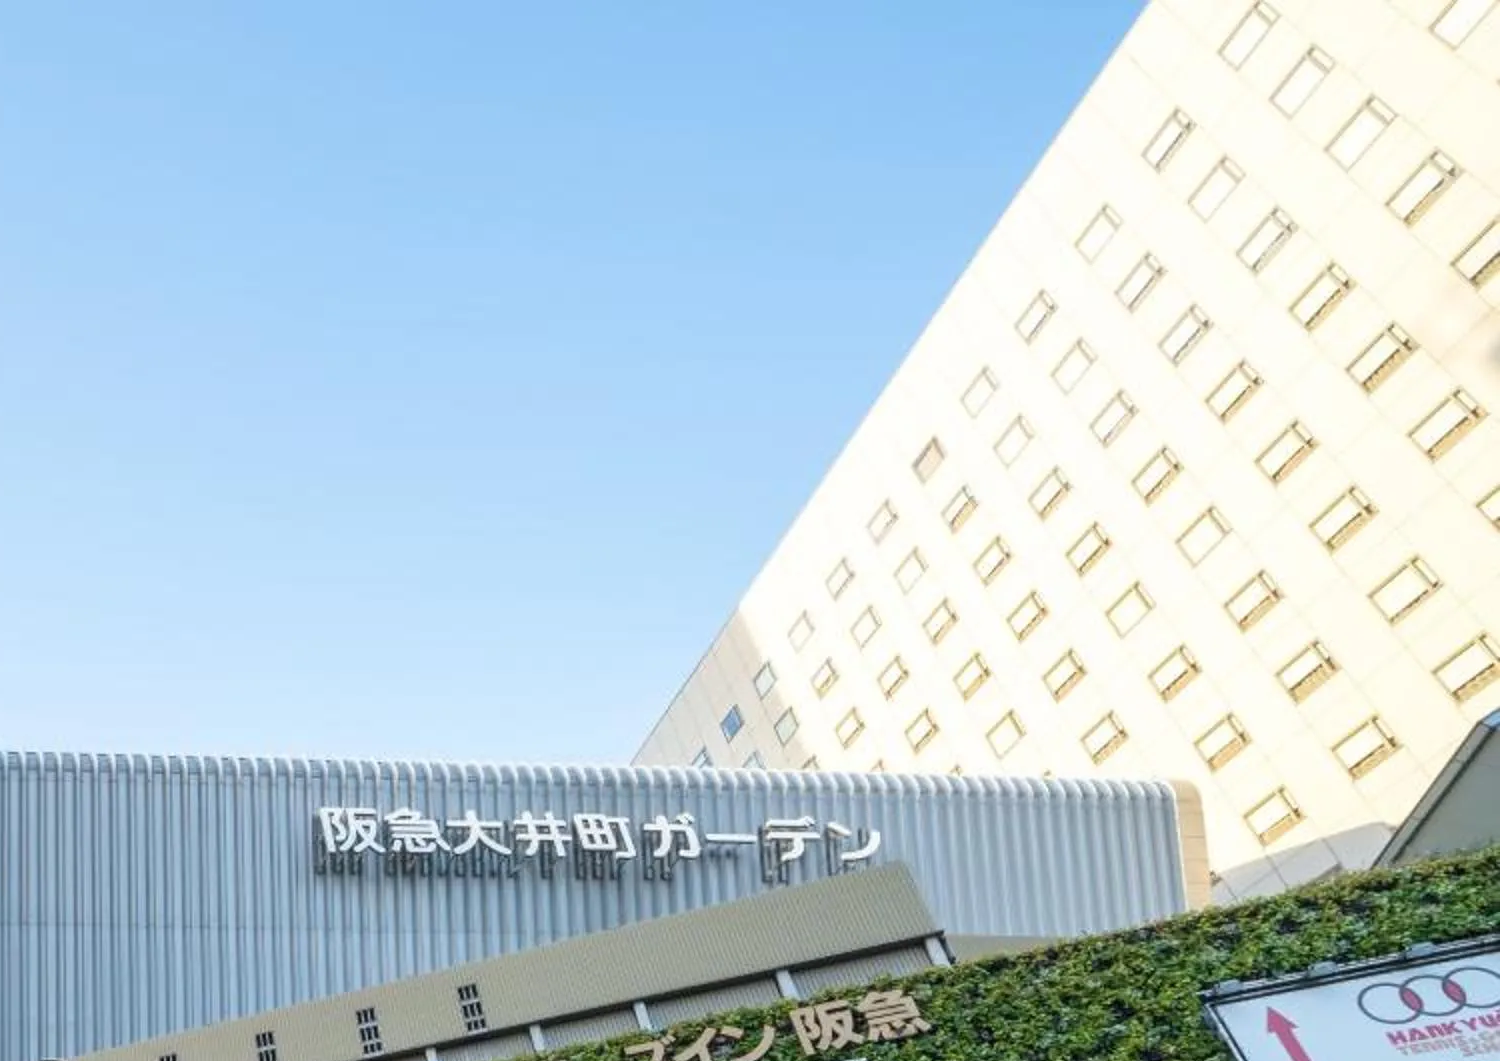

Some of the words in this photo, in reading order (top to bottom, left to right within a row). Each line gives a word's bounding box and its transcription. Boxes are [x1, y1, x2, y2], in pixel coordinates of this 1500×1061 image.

[318, 806, 883, 862] 阪急大井町ガーデン
[790, 988, 932, 1056] 阪急
